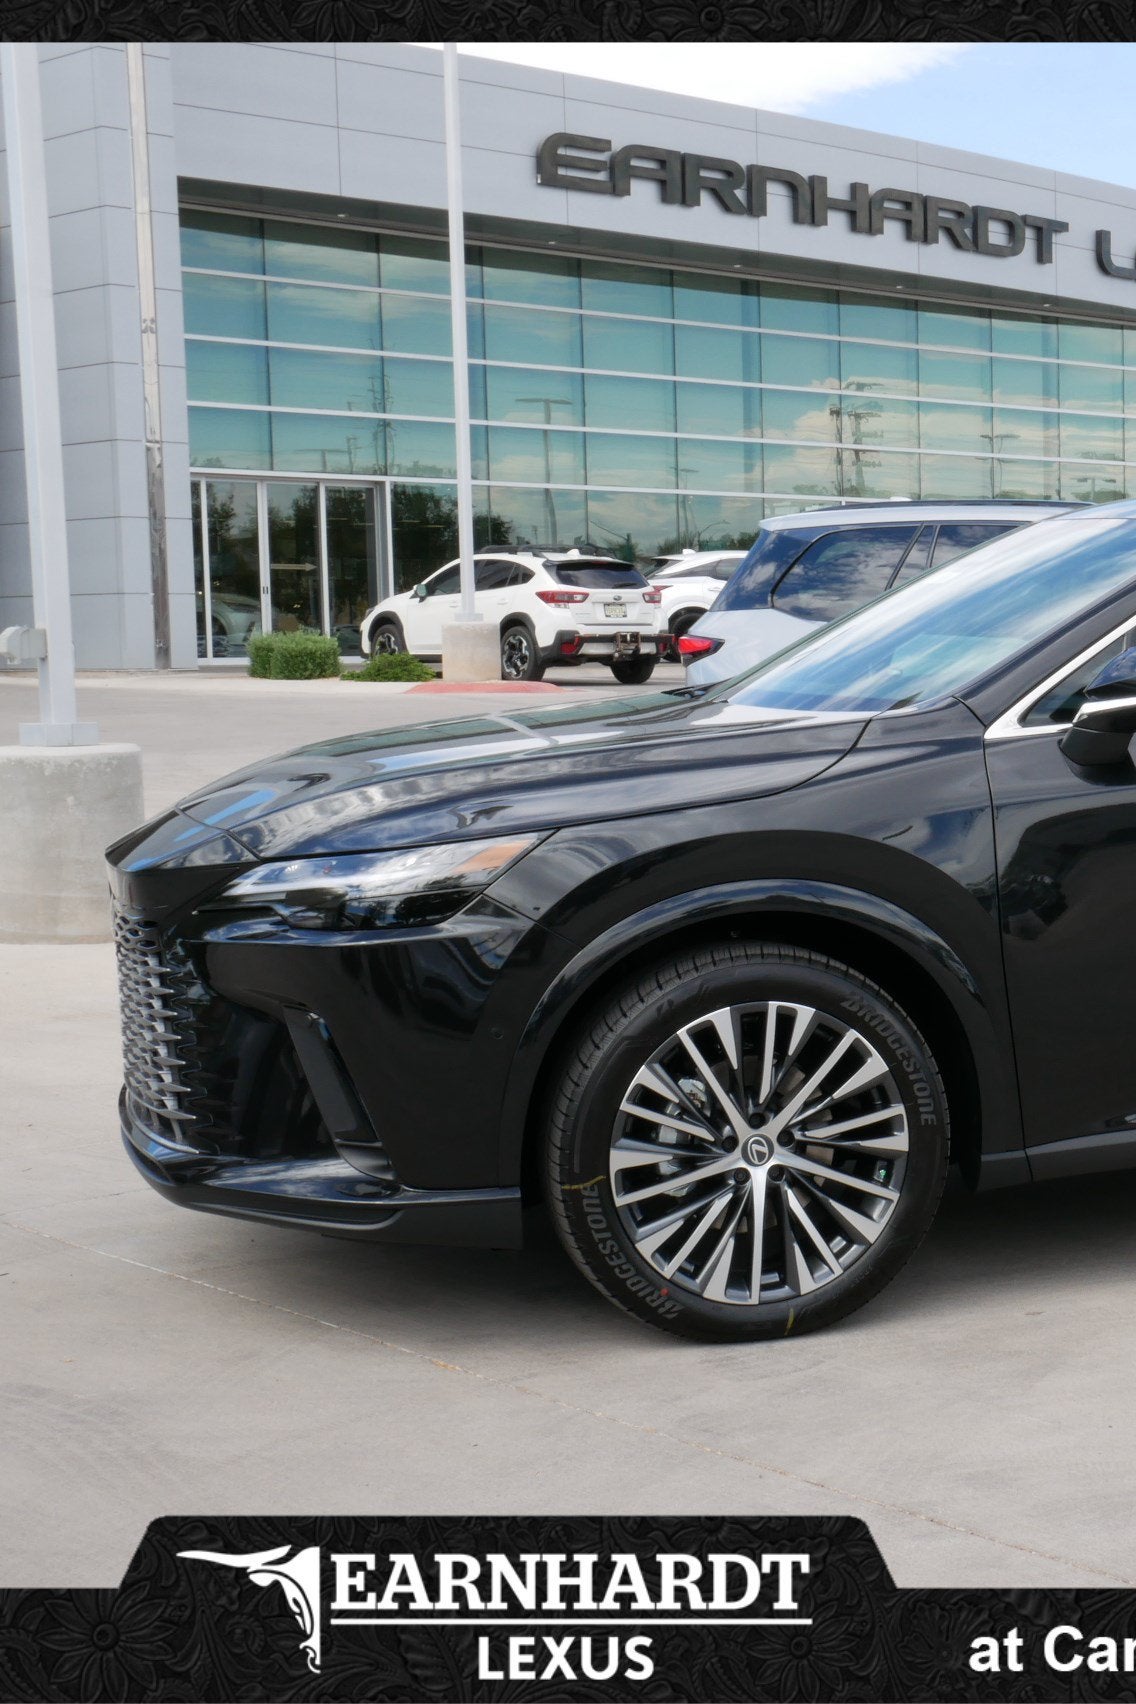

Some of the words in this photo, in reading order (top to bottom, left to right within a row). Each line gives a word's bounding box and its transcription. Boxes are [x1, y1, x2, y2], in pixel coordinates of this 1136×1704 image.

[536, 132, 1069, 265] EARNHARDT
[840, 994, 937, 1126] BRIDGESTONE
[582, 1184, 685, 1319] BRIDGESTONE
